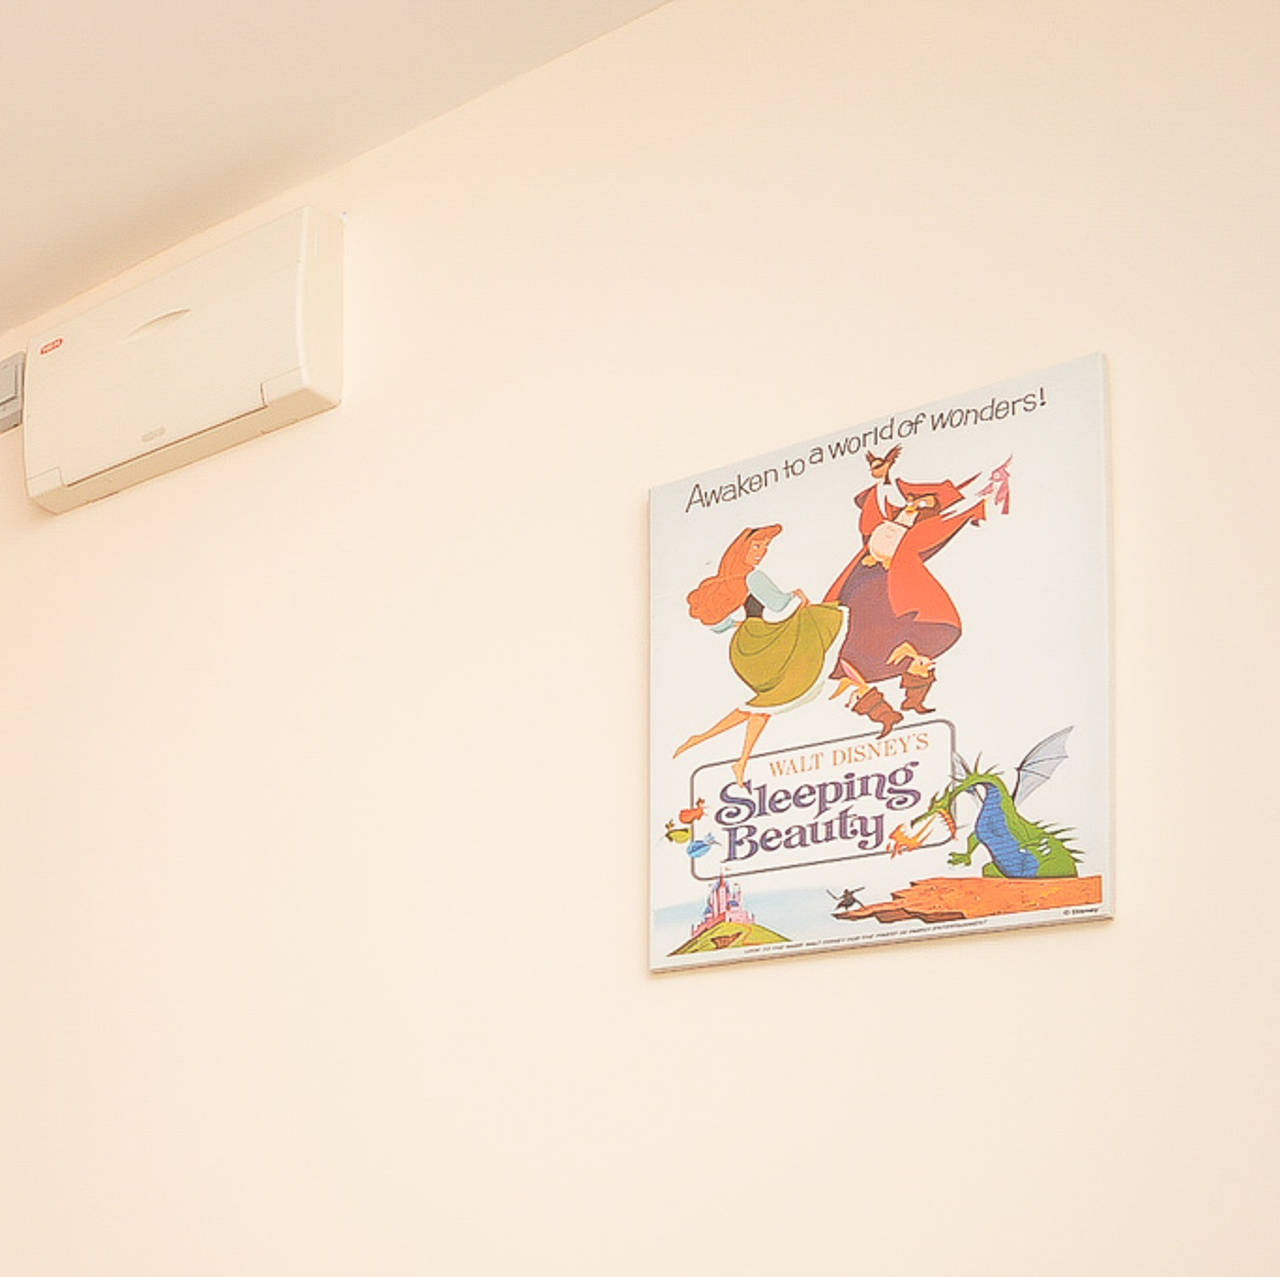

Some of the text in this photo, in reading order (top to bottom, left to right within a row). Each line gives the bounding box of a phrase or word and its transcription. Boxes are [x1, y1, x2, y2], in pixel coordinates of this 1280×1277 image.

[685, 386, 1047, 513] Awaken to a world of wonders!
[769, 733, 929, 778] WALT DISNEY'S
[714, 760, 922, 827] Sleeping
[720, 804, 885, 864] Beauty
